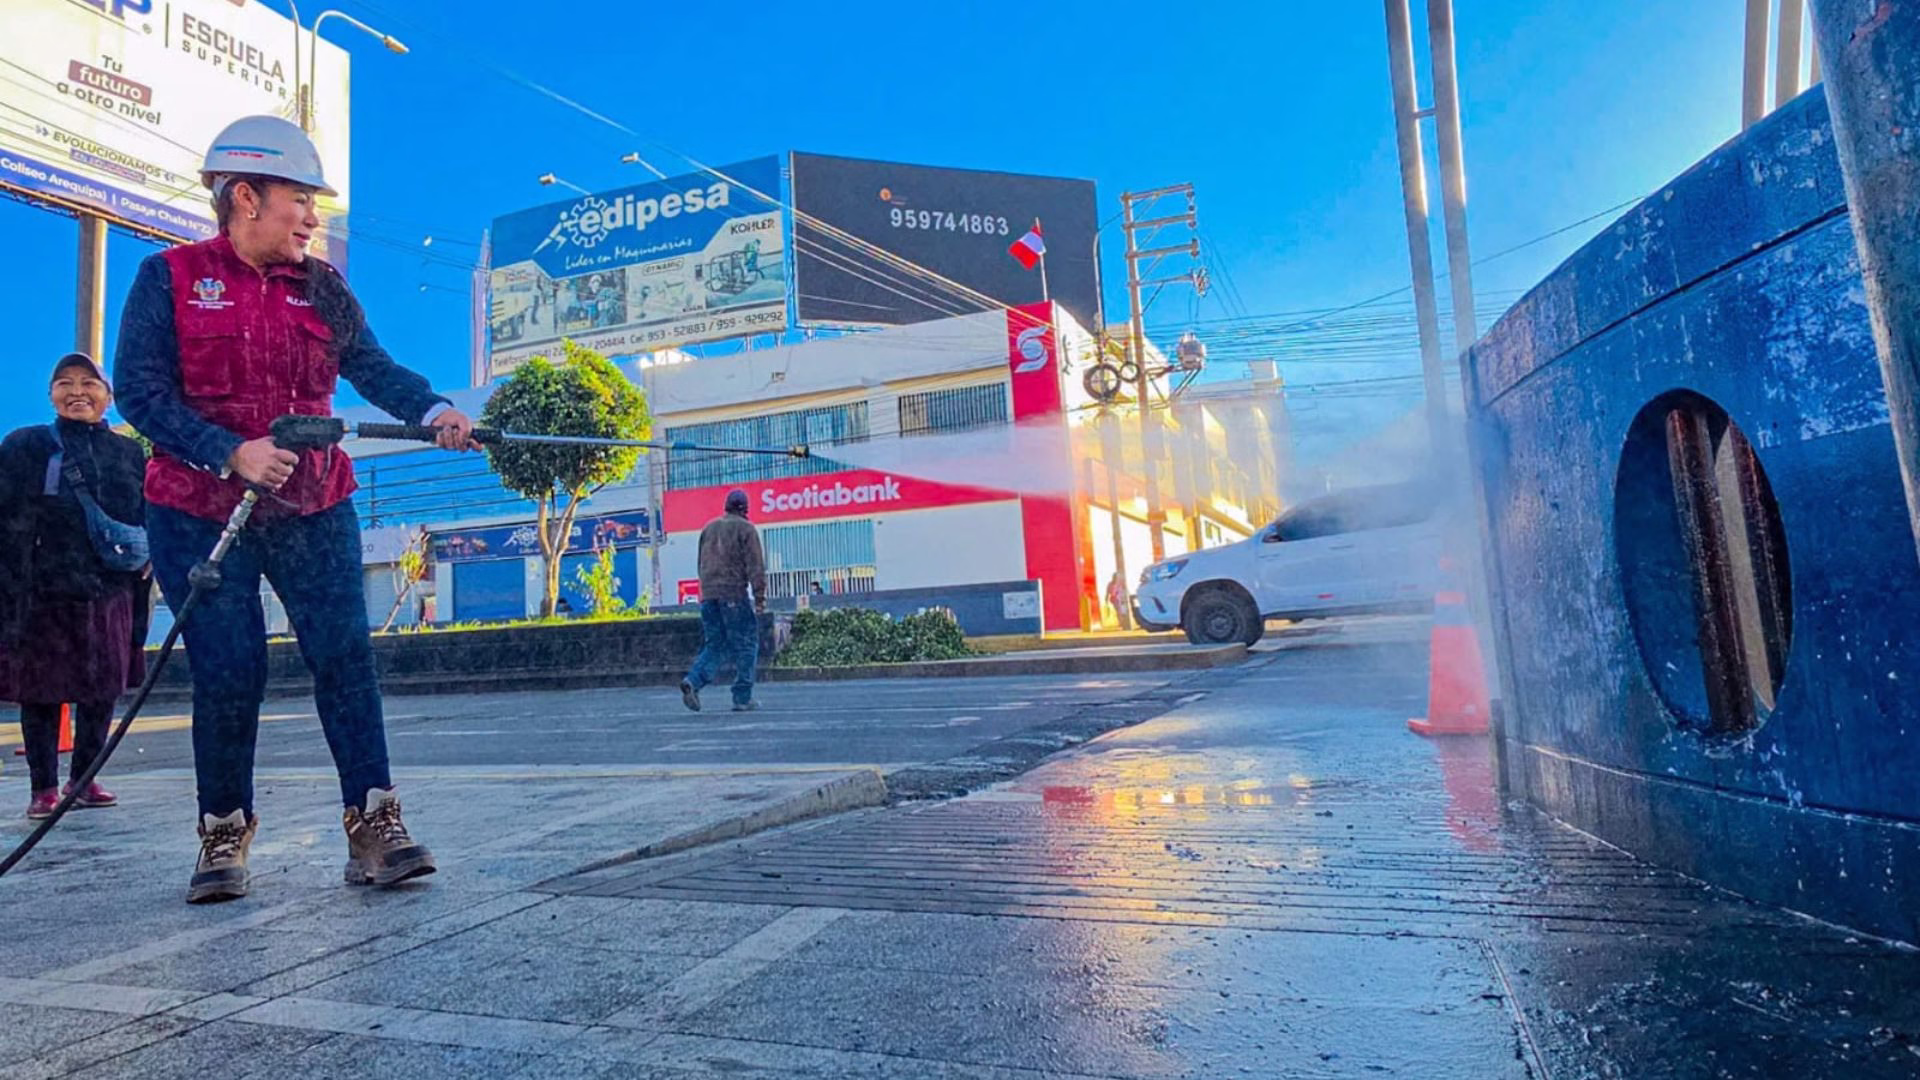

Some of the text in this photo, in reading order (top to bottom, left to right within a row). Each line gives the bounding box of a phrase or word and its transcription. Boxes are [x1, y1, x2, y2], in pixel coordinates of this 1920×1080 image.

[101, 54, 123, 74] Tu
[182, 12, 285, 83] ESCUELA
[79, 65, 143, 101] futuro
[181, 40, 287, 100] SUPERIOR
[56, 81, 162, 126] a otro nivel
[1, 156, 48, 181] Coliseo
[53, 131, 162, 177] EVOLUCIONAMOS
[579, 181, 730, 234] edipesa
[890, 208, 1009, 236] 959741863
[730, 217, 775, 236] KOHLER
[744, 311, 784, 326] 929292
[761, 475, 901, 513] Scotiabank
